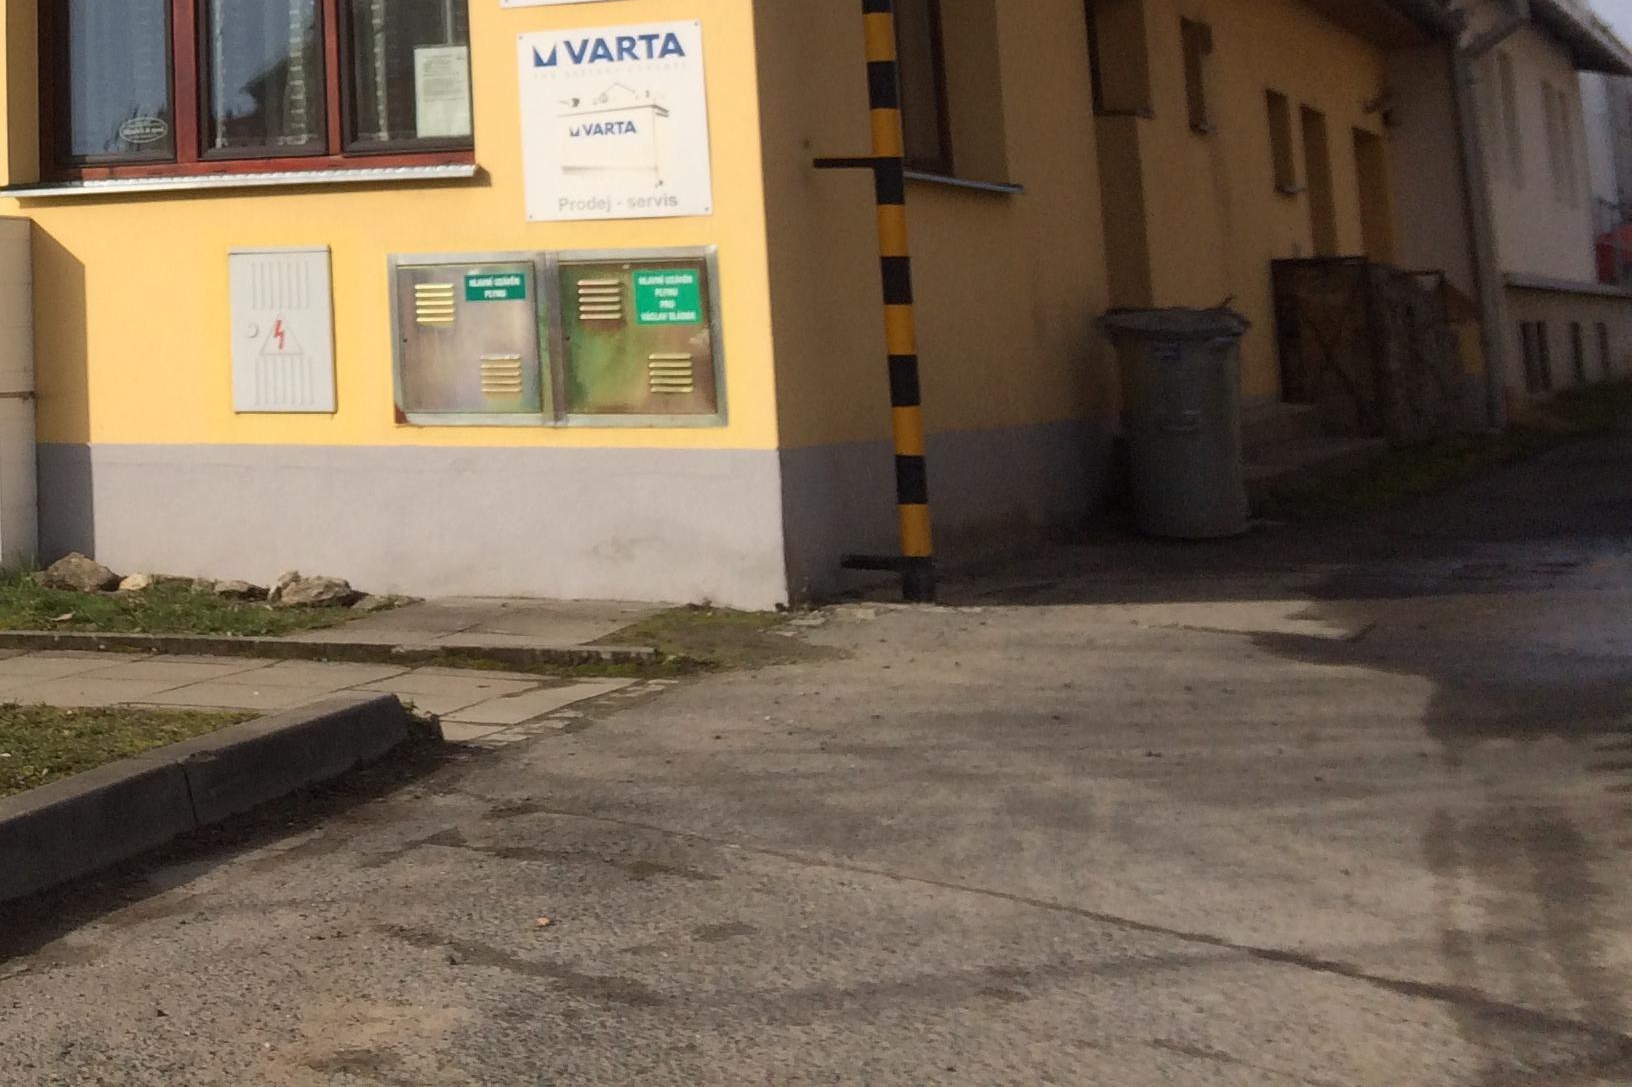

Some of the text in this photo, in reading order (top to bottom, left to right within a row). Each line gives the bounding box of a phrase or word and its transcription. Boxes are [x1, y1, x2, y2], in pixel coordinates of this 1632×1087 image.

[563, 32, 686, 64] VARTA
[581, 121, 636, 136] VARTA
[558, 196, 611, 213] Prodej
[627, 193, 678, 209] servis
